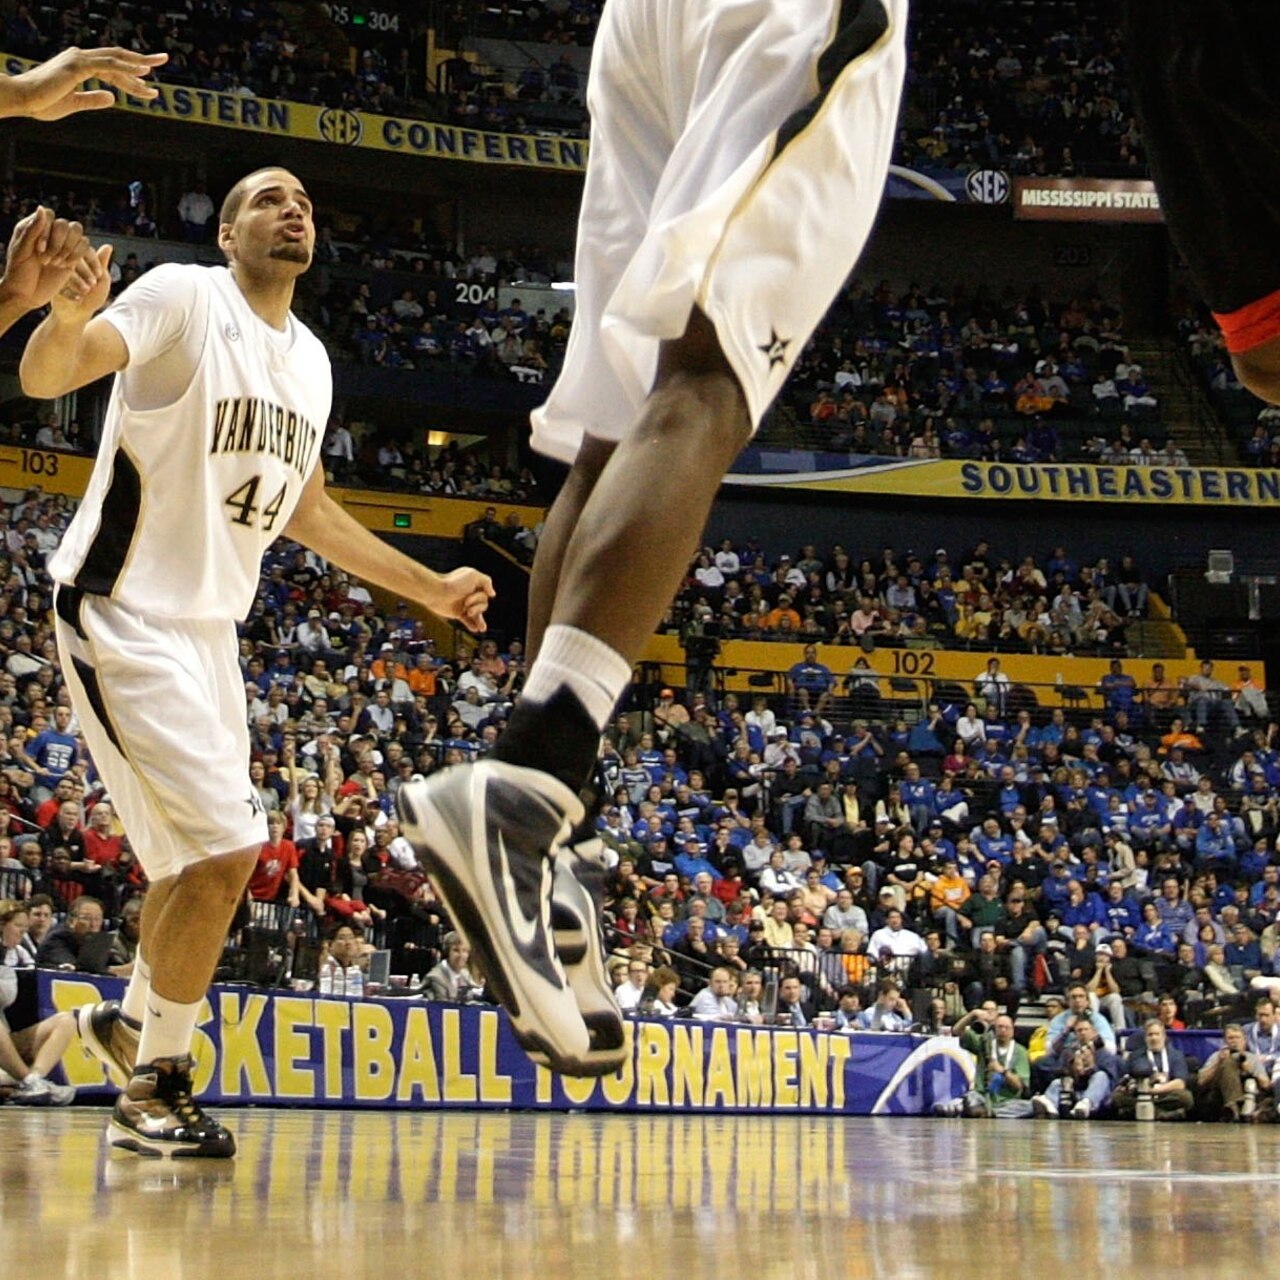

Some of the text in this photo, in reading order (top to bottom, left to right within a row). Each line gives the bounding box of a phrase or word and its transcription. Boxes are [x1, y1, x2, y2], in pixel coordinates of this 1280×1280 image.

[367, 10, 400, 33] 304
[319, 109, 362, 146] SEC
[382, 120, 588, 166] CONFEREN
[970, 169, 1009, 204] SEC
[1022, 189, 1160, 209] MISSISSIPPI STATE
[455, 282, 497, 306] 204
[208, 397, 316, 483] VANDERBILT
[19, 450, 59, 476] 103
[224, 475, 288, 531] 44
[892, 651, 936, 676] 102
[51, 979, 513, 1102] BSKETBALL
